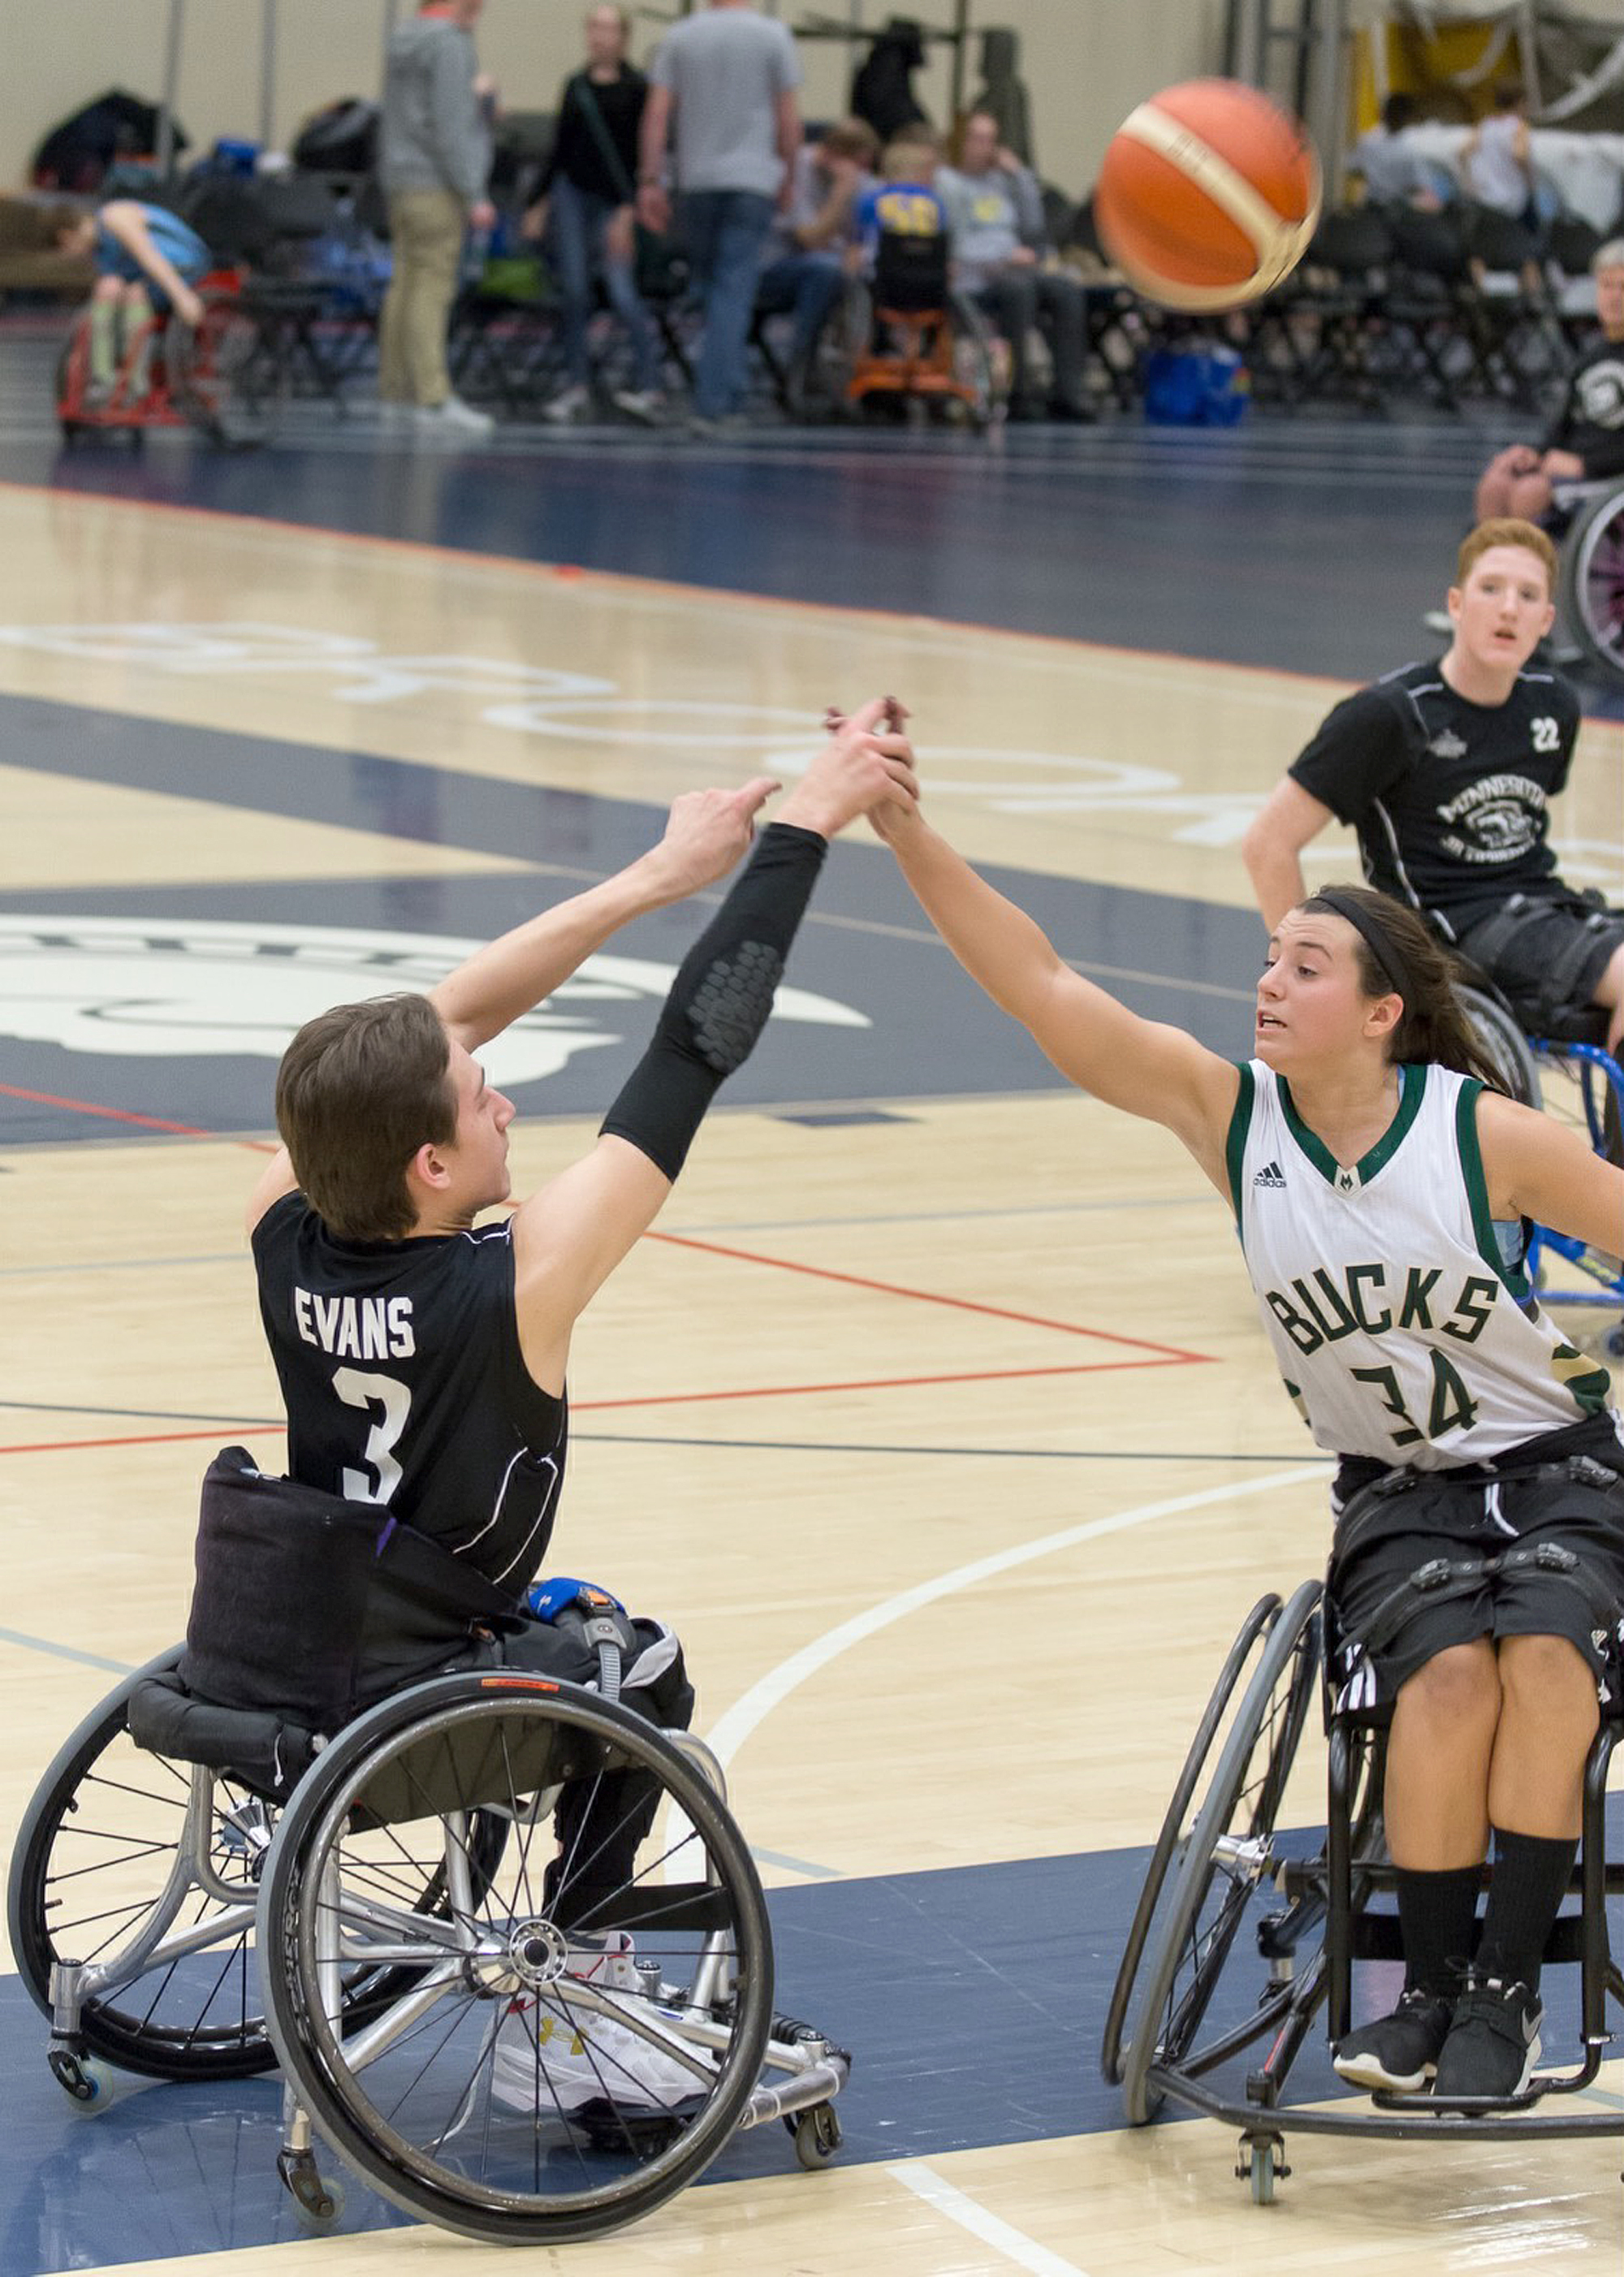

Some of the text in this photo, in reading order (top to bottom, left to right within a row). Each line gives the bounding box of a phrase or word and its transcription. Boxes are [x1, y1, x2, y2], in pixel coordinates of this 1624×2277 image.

[1530, 715, 1561, 753] 22
[1253, 1177, 1287, 1188] adidas
[294, 1285, 416, 1360] EVANS
[1264, 1263, 1499, 1357] BUCKS
[331, 1366, 412, 1506] 3
[1349, 1347, 1479, 1448] 34
